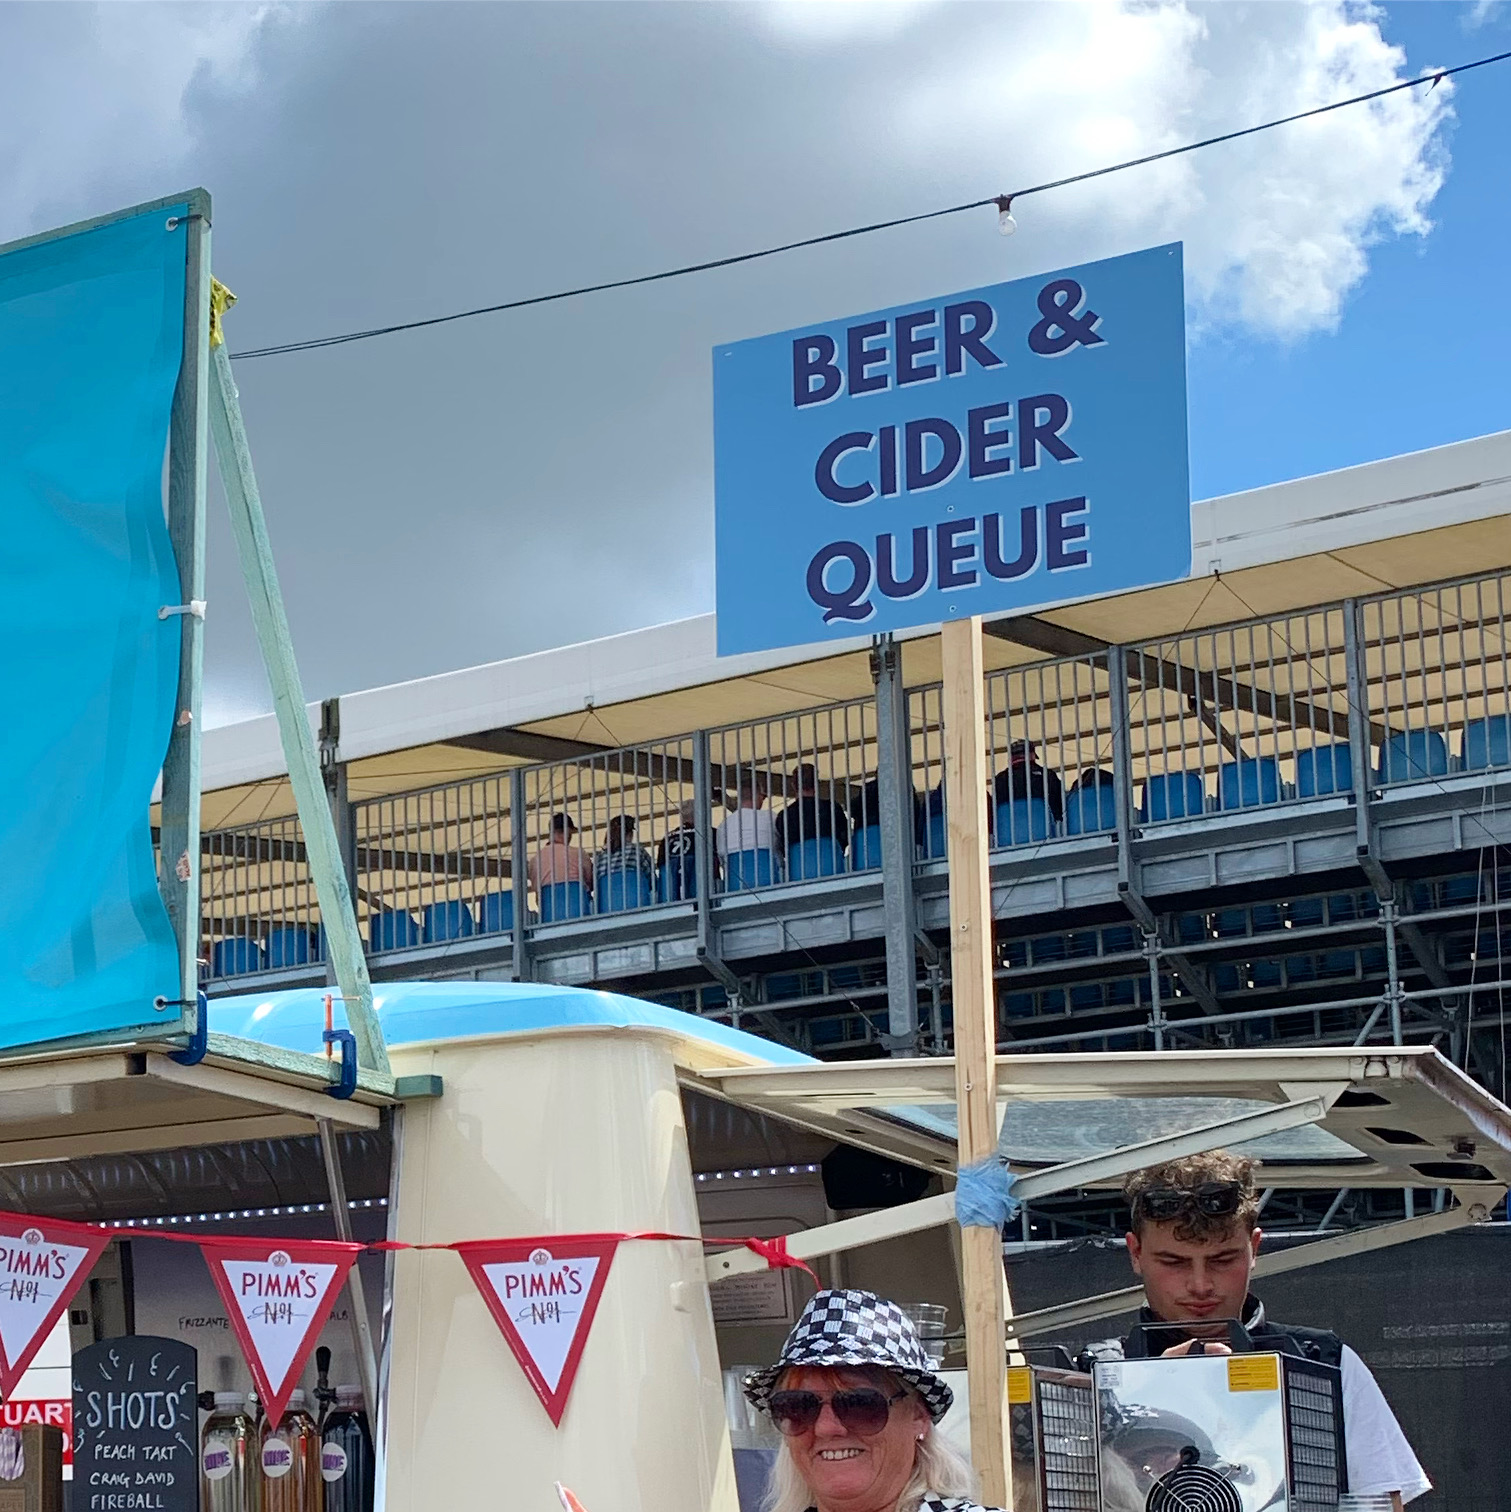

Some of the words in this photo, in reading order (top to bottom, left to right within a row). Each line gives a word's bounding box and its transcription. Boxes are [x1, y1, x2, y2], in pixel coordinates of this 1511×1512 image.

[793, 300, 1007, 408] BEER
[1027, 279, 1107, 358] &
[814, 393, 1082, 506] CIDER
[806, 496, 1090, 625] QUEUE
[242, 1269, 317, 1298] PIMM'S
[505, 1266, 582, 1298] PIMM'S
[87, 1391, 180, 1430] SHOTS
[95, 1444, 135, 1460] PEACH
[143, 1446, 177, 1460] TART
[90, 1472, 129, 1488] CRAIG
[135, 1472, 175, 1486] DAVID
[91, 1494, 164, 1509] FIREBALL
